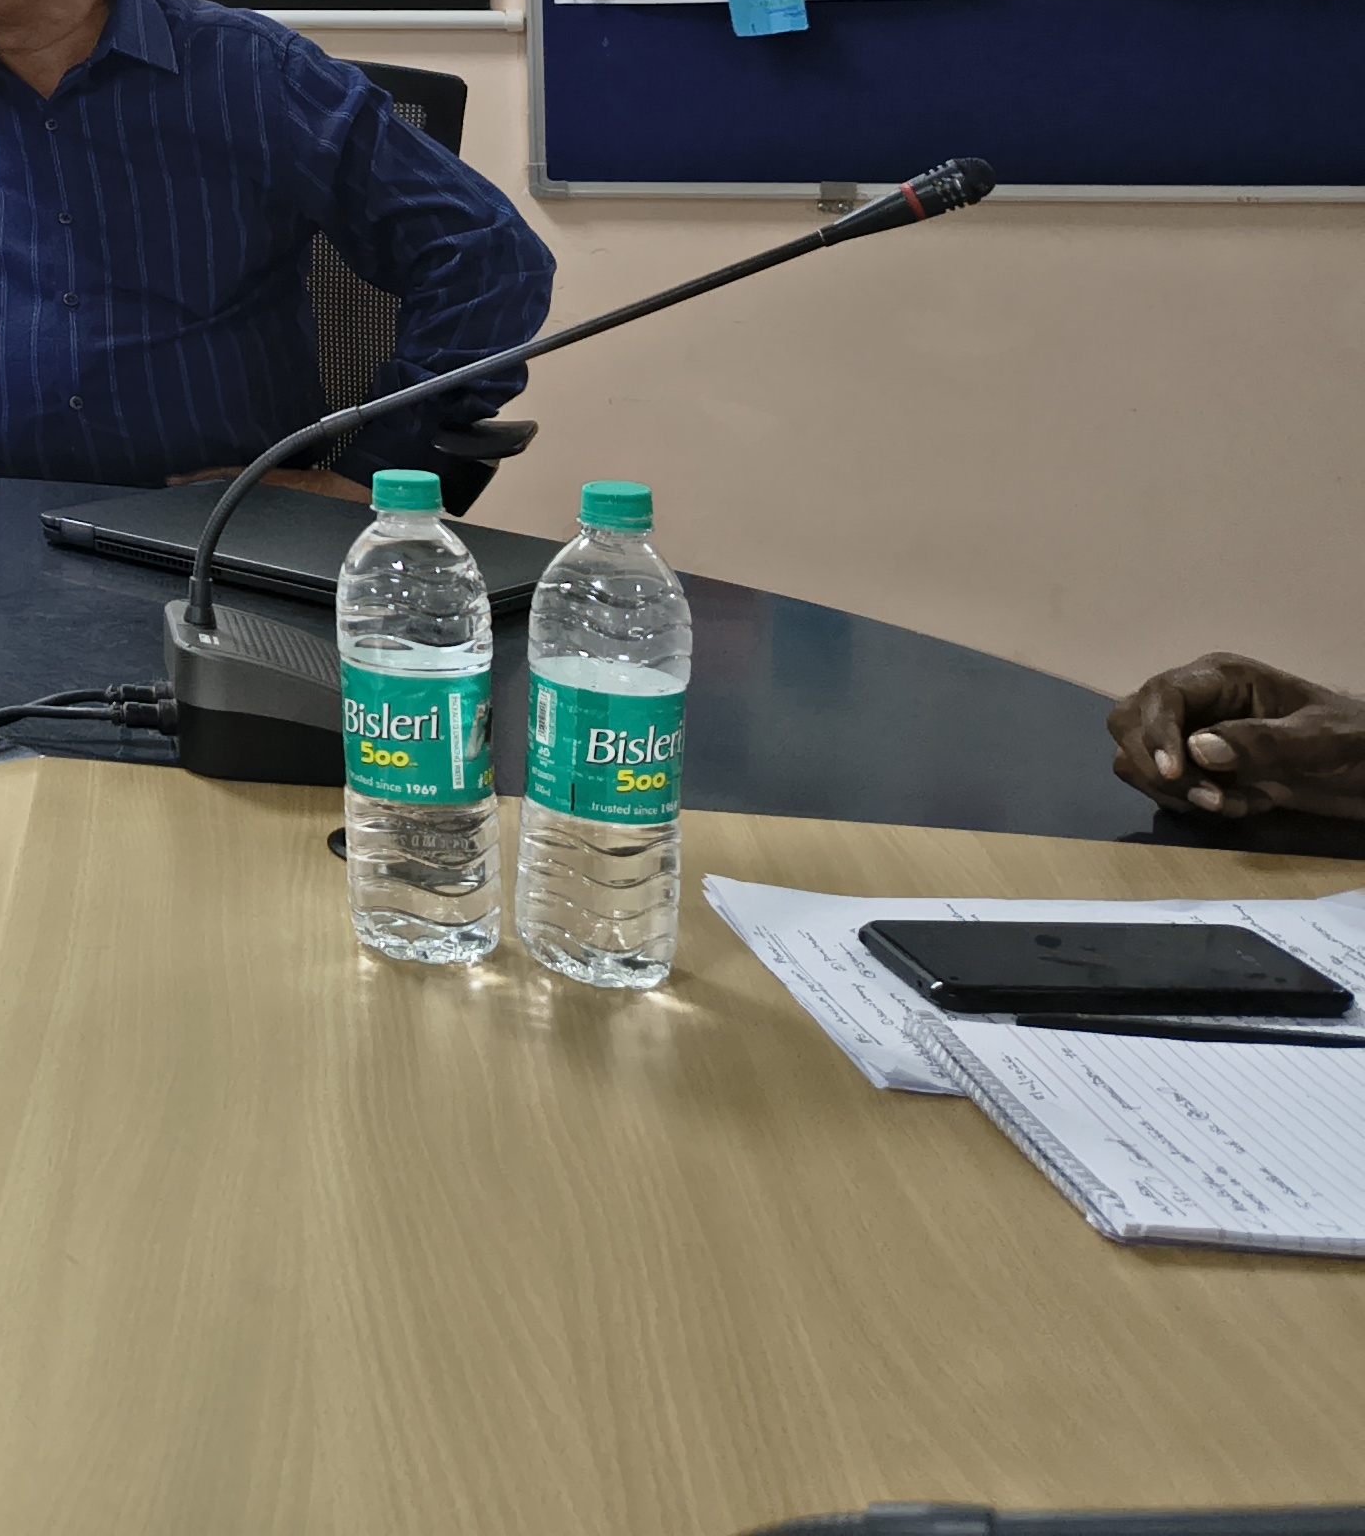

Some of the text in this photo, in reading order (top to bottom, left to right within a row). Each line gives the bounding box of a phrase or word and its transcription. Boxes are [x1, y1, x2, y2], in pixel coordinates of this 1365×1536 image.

[344, 698, 440, 741] Bisleri
[361, 741, 410, 767] 500
[586, 720, 683, 765] Bisleri
[375, 778, 402, 793] since
[406, 783, 438, 796] 1969
[616, 769, 667, 793] 500
[592, 801, 631, 815] trusted
[634, 805, 658, 815] since
